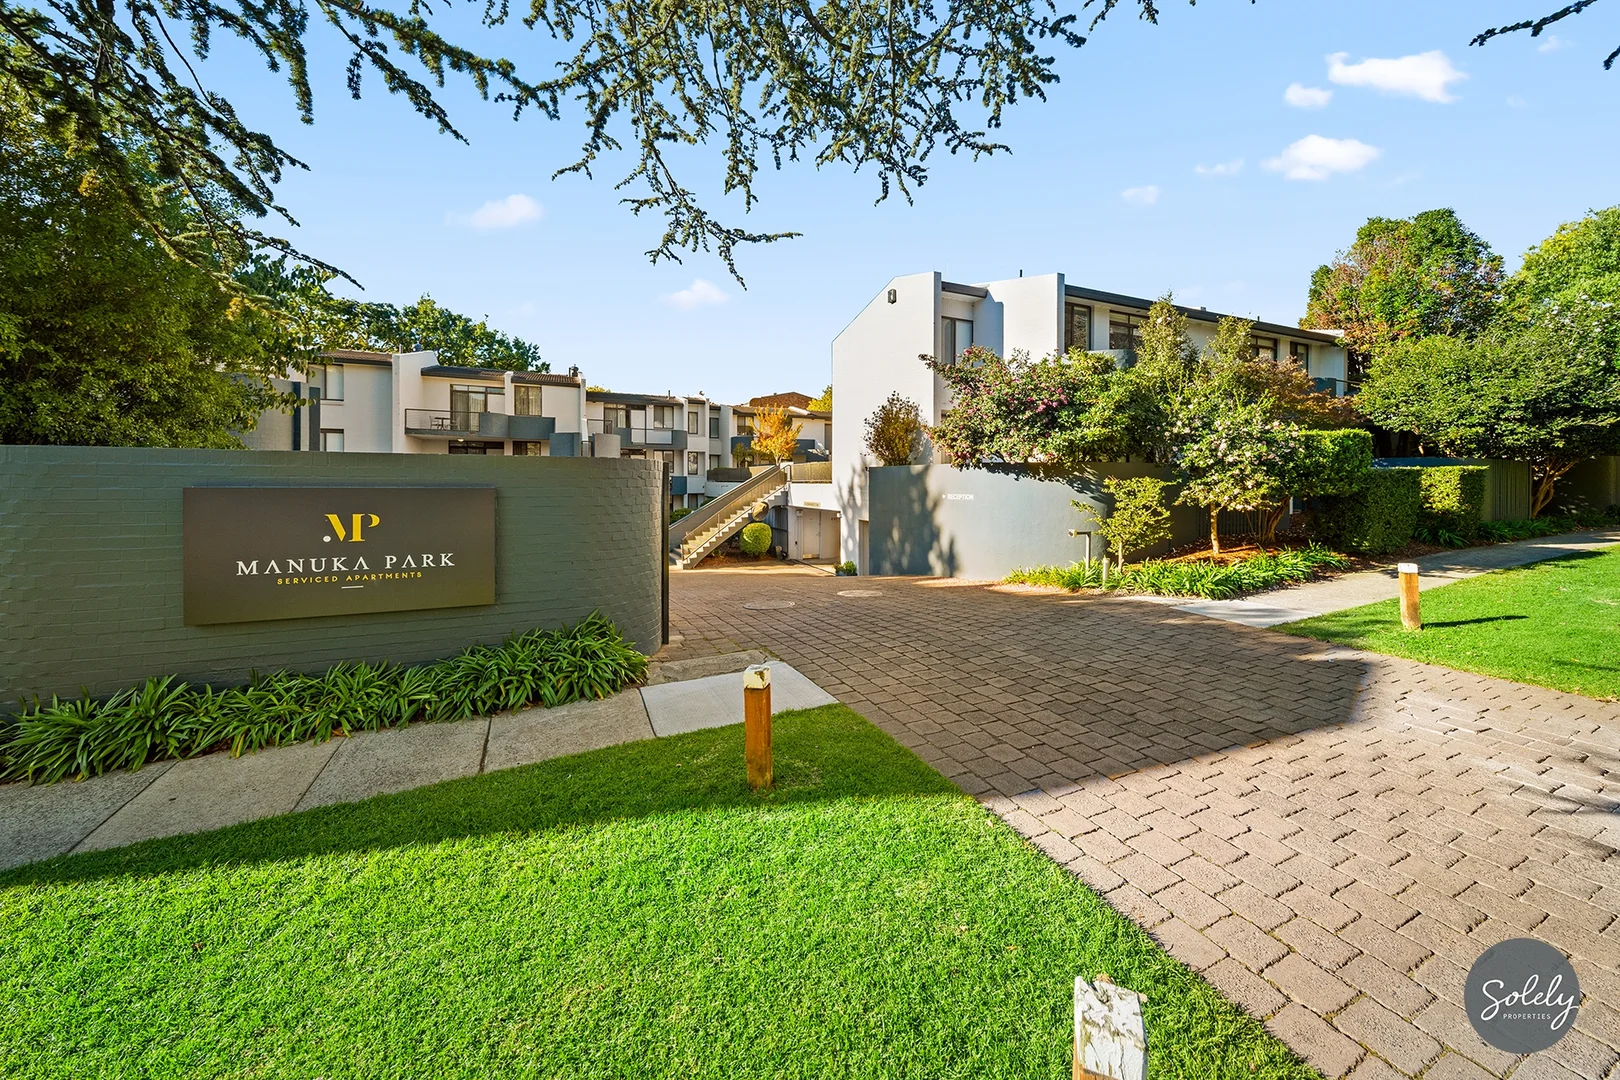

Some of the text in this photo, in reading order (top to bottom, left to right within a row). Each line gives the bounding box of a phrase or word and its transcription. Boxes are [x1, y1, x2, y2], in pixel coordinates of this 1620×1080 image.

[236, 553, 455, 576] MANUKA PARK
[277, 571, 422, 585] SERVICED APARTMENTS
